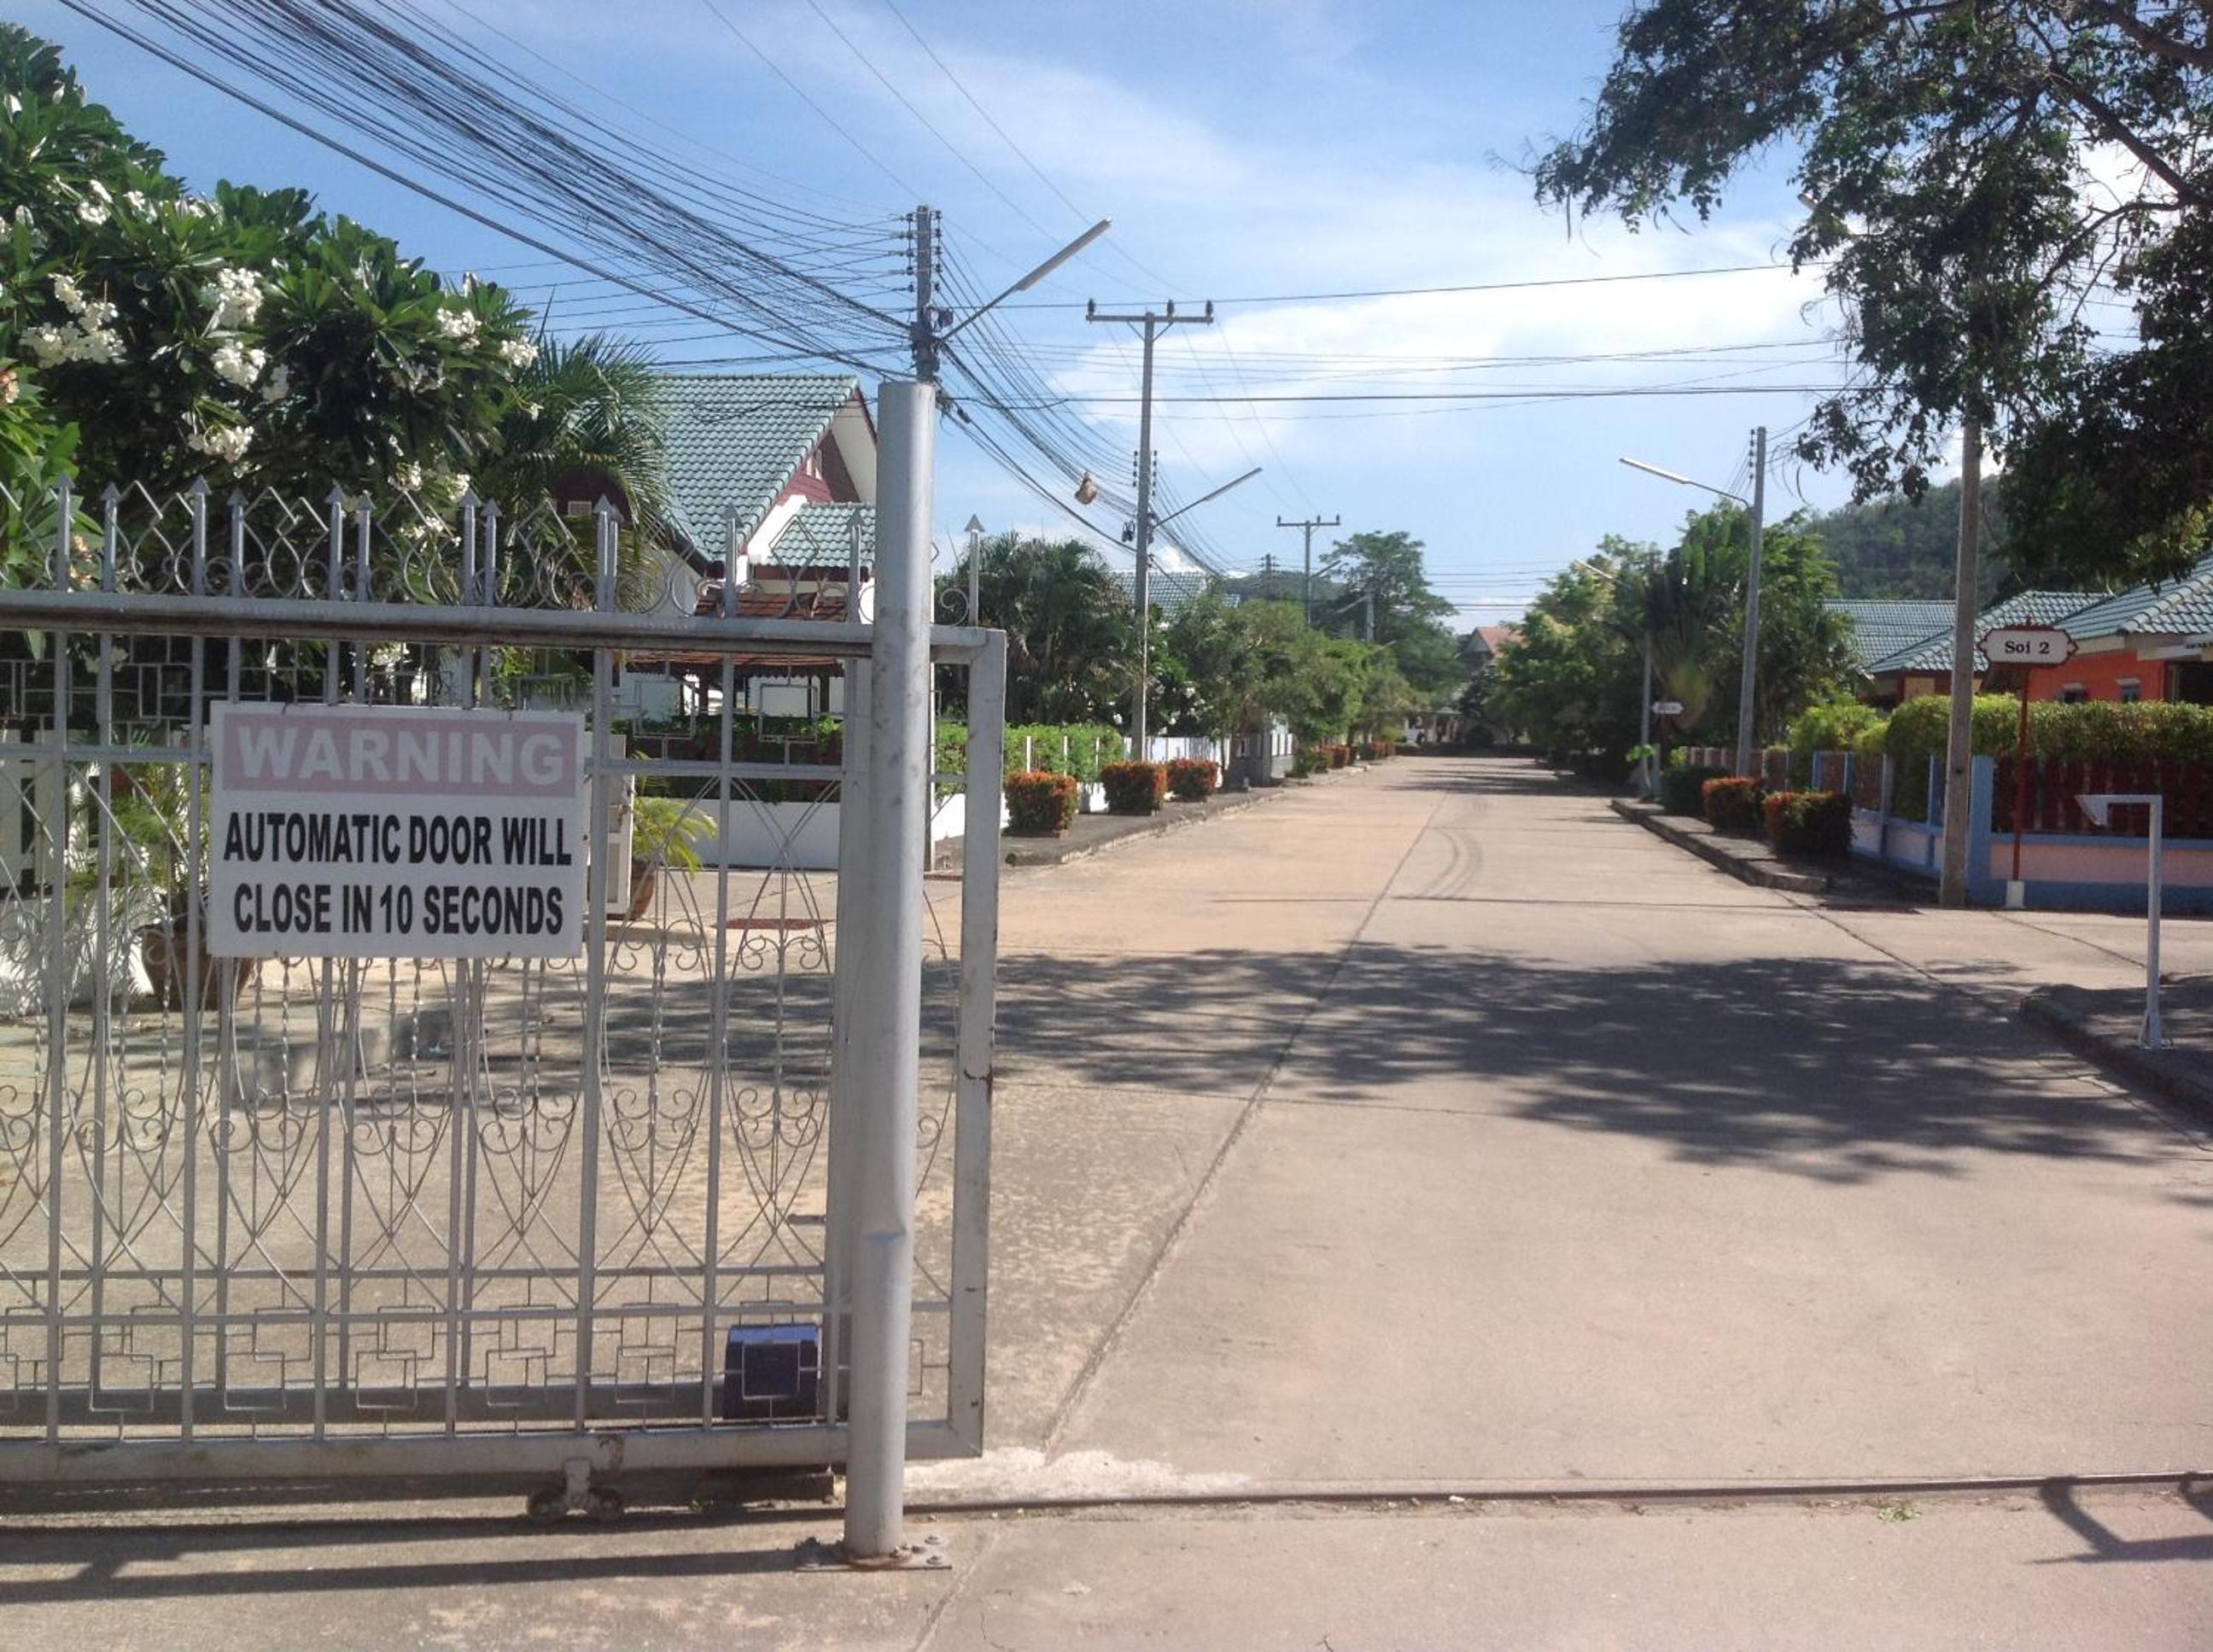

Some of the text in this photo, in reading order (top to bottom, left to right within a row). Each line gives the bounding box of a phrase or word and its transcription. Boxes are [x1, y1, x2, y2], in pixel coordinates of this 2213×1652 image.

[2005, 641, 2050, 654] Soi 2
[237, 727, 564, 785] WARNING
[224, 812, 572, 866] AUTOMATIC DOOR WILL
[234, 883, 563, 935] CLOSE IN 10 SECONDS
